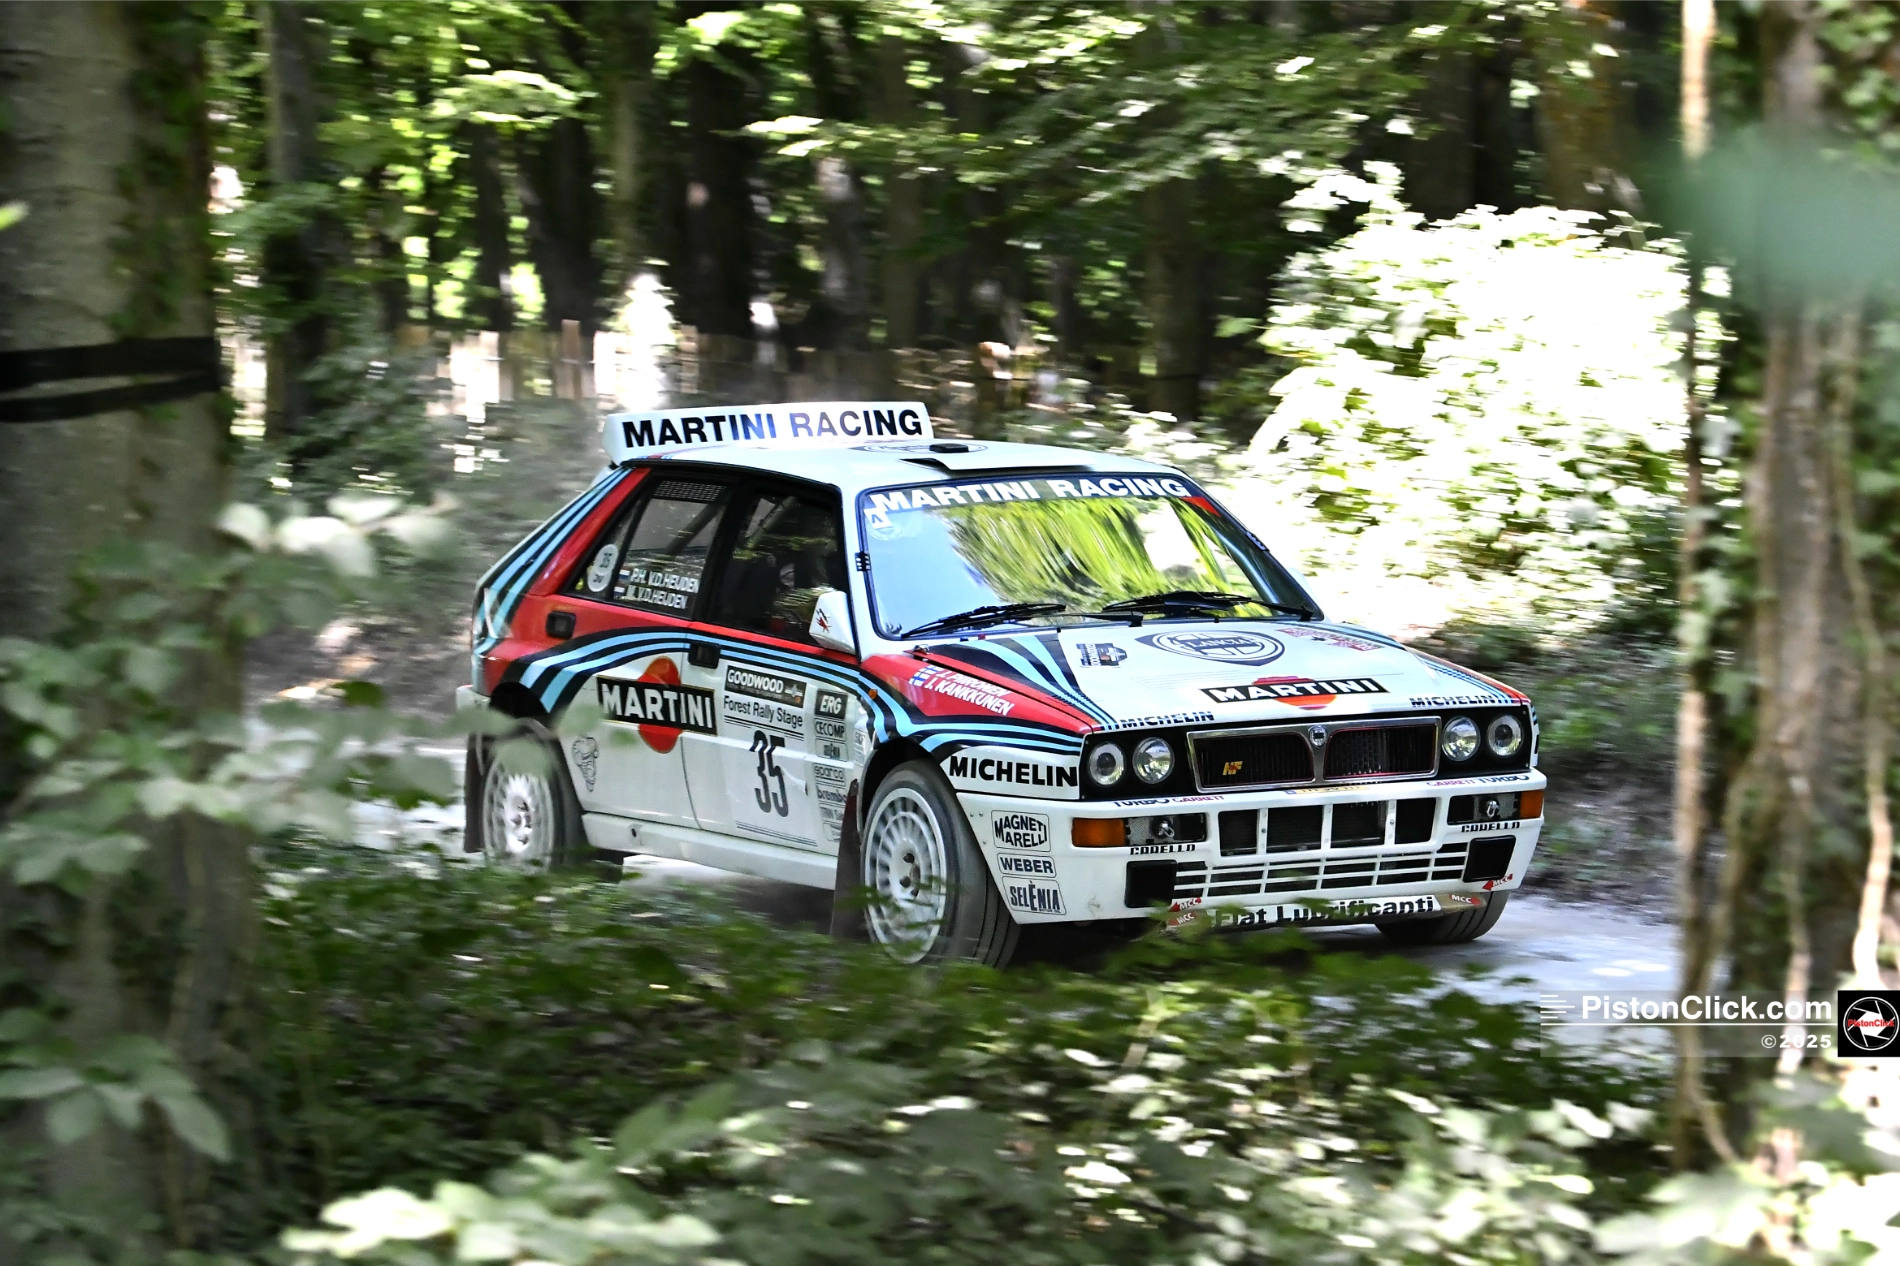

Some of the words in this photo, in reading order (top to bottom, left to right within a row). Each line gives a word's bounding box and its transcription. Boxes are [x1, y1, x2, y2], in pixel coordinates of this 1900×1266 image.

[623, 413, 777, 447] MARTINI
[789, 409, 922, 437] RACING
[870, 480, 1040, 512] MARTINI
[1047, 476, 1190, 498] RACING
[727, 669, 784, 694] GOODWOOD
[1208, 679, 1380, 702] MARTINI
[601, 683, 713, 728] MARTINI
[820, 695, 842, 714] ERG
[935, 680, 1015, 716] KANKKUNEN
[1409, 694, 1494, 707] MICHELIN
[723, 695, 751, 715] Forest
[753, 701, 774, 723] Rally
[776, 707, 803, 729] Stage
[1120, 711, 1215, 728] MICHELIN
[815, 721, 845, 738] CECOMP
[749, 730, 789, 818] 35
[814, 765, 844, 780] sparco
[949, 756, 1078, 787] MICHELIN
[994, 814, 1048, 842] MAGNETI
[1000, 856, 1053, 874] WEBER
[1179, 898, 1198, 911] MCC
[1451, 895, 1472, 905] MCC
[1176, 912, 1195, 925] MCC
